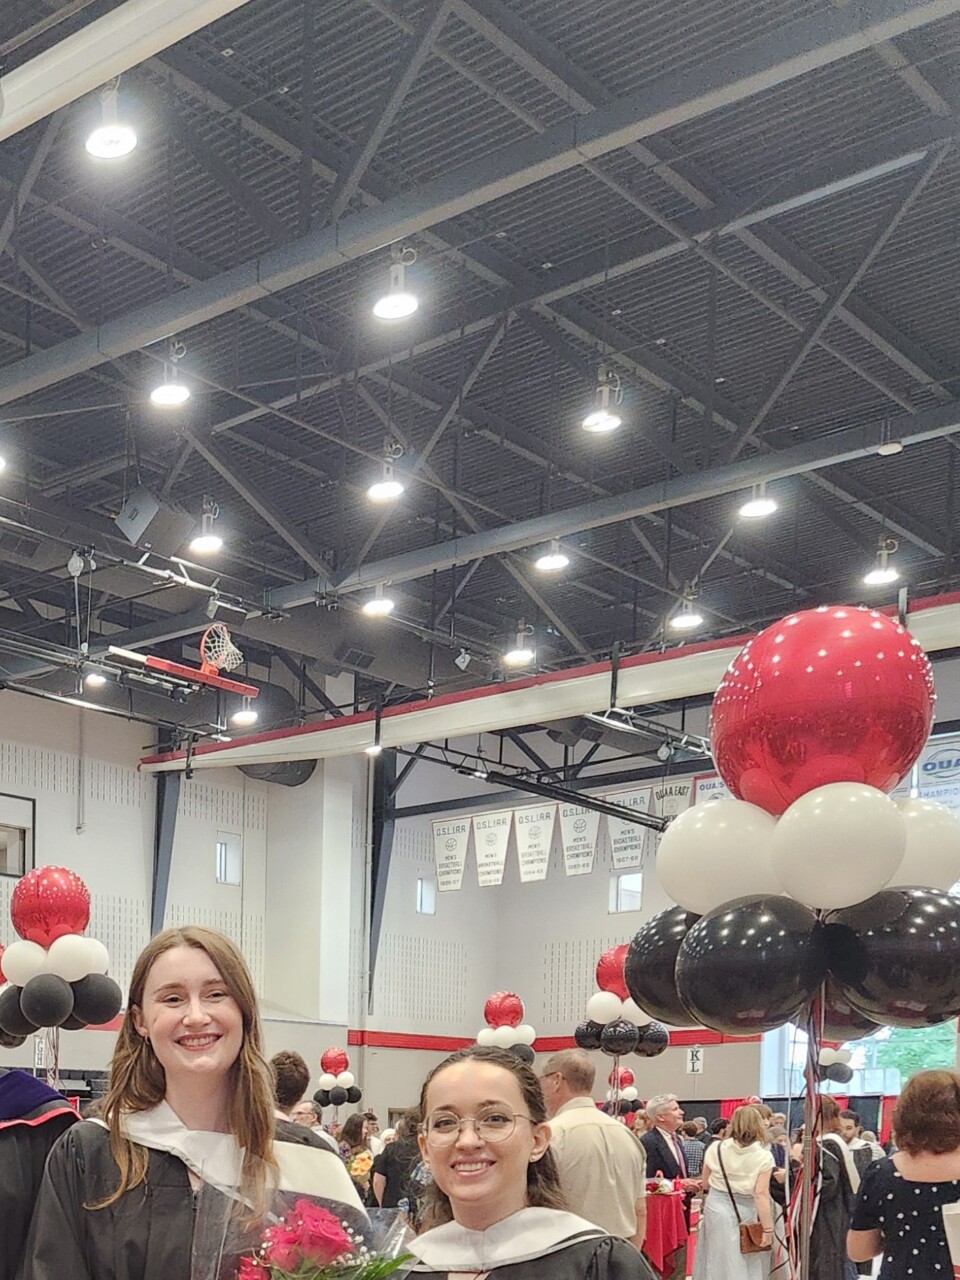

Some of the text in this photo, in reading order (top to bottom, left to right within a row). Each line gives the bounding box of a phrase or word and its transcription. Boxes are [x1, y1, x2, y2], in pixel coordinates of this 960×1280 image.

[674, 785, 690, 797] EAST
[37, 1040, 44, 1053] G
[36, 1052, 44, 1066] H
[690, 1049, 701, 1062] K
[690, 1061, 700, 1073] L
